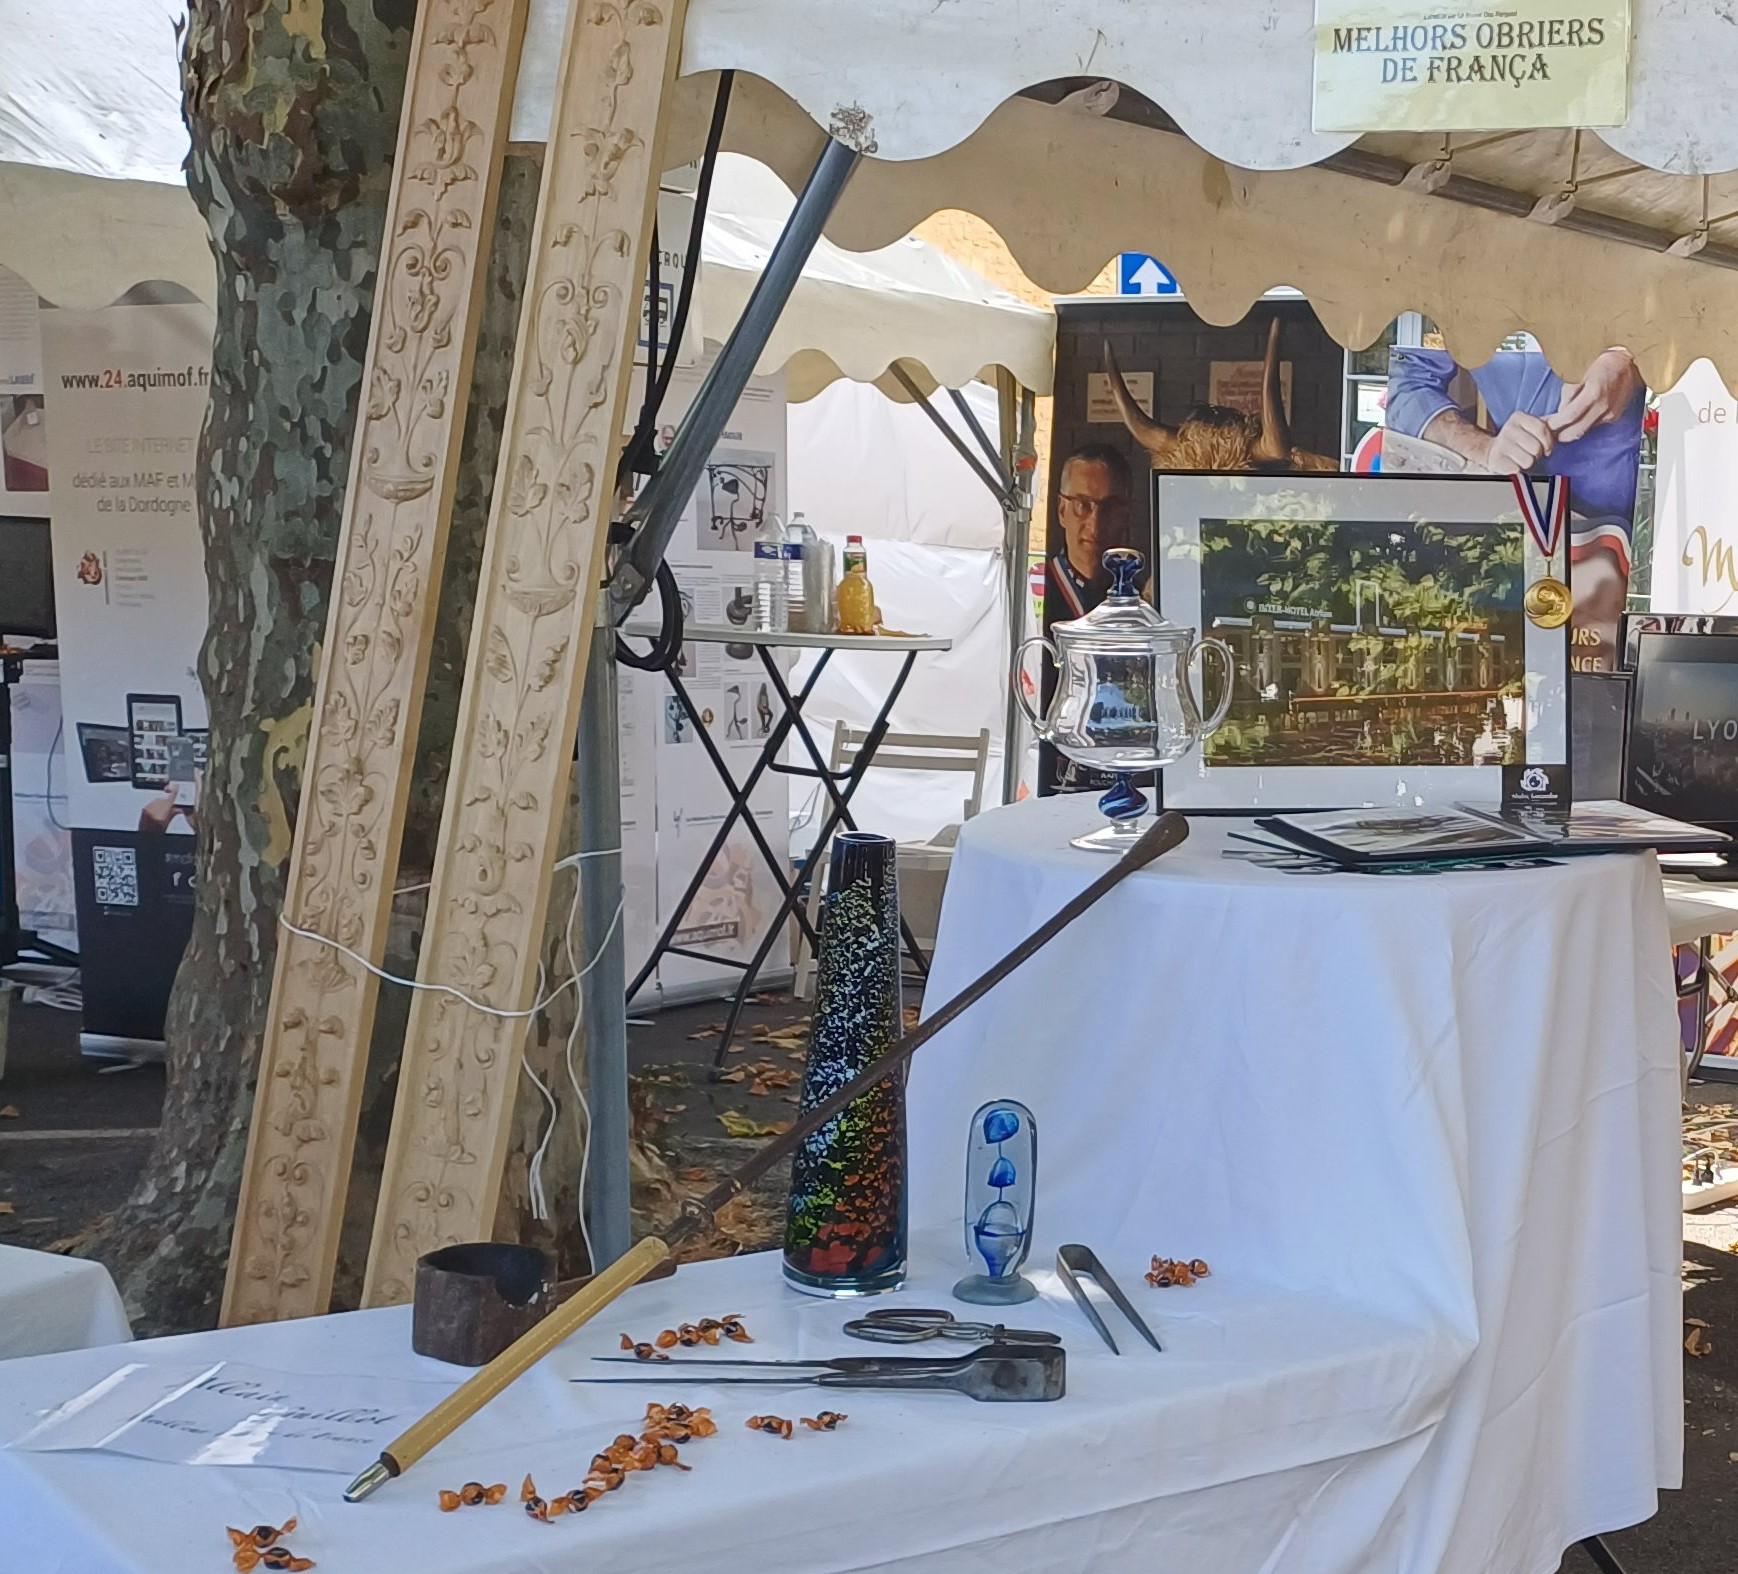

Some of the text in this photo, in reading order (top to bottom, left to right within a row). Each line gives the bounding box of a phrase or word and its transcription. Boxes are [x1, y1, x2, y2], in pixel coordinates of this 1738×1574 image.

[1332, 18, 1605, 54] MELHORS OBRIERS
[1381, 53, 1552, 88] DE FRANÇA
[61, 366, 210, 392] www.24.aquimof.fr
[1698, 400, 1726, 424] de
[129, 496, 191, 516] Dordogne
